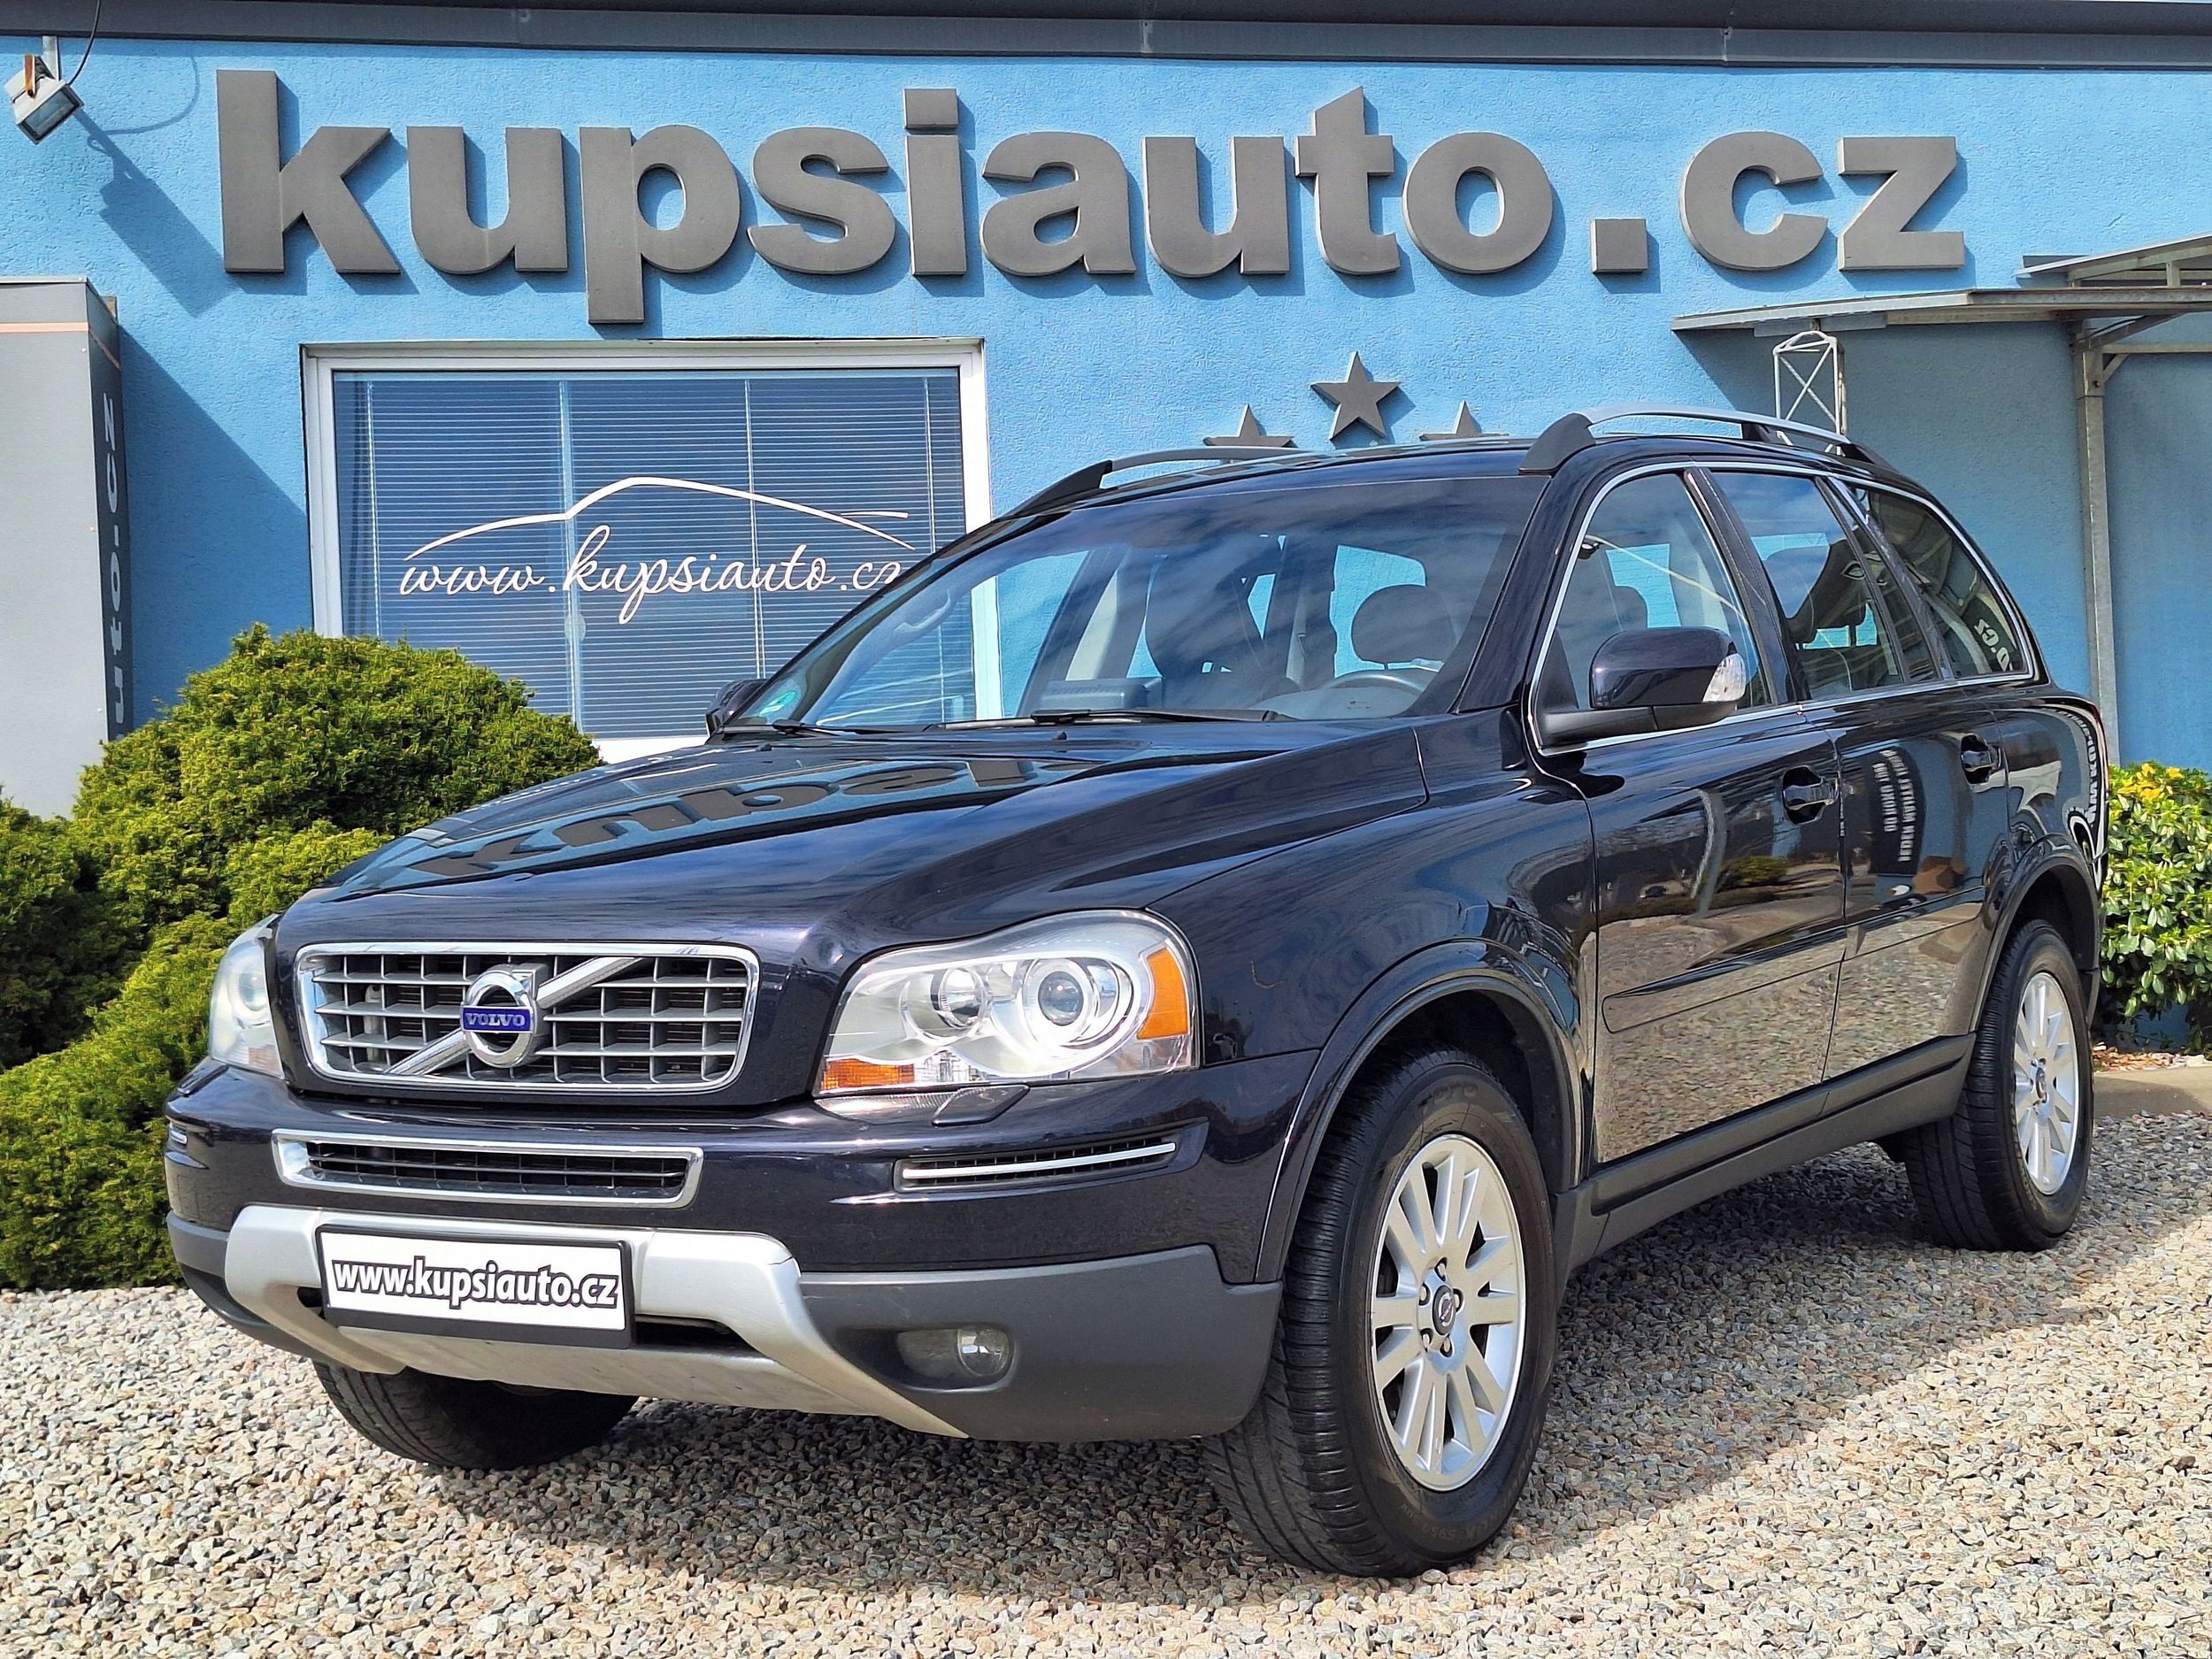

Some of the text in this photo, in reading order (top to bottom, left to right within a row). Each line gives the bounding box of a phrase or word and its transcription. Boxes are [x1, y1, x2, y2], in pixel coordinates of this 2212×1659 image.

[216, 69, 1965, 324] kupsiauto.cz
[103, 392, 125, 741] uto.cz
[465, 1012, 526, 1027] VOLVO
[332, 1255, 619, 1310] www.kupsiauto.cz
